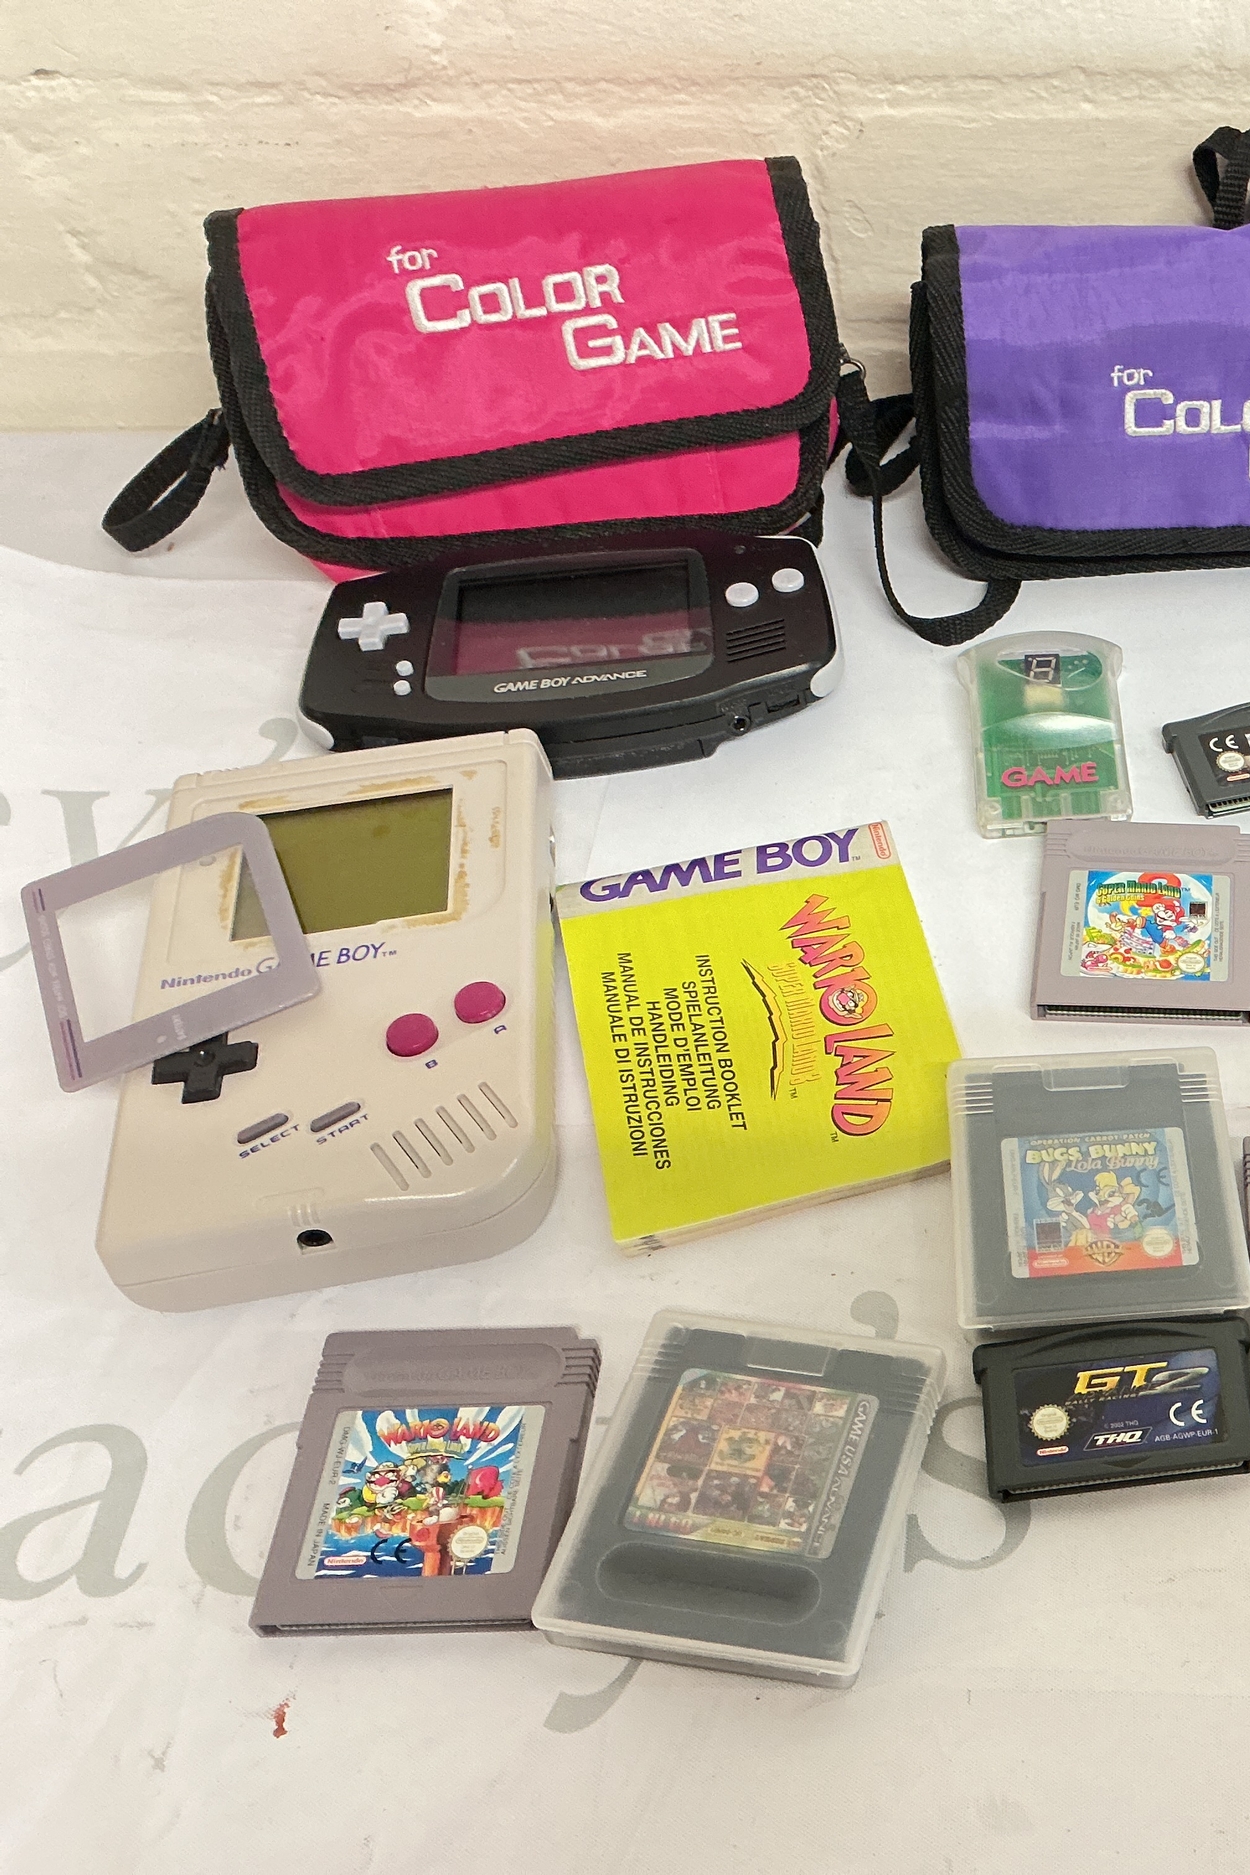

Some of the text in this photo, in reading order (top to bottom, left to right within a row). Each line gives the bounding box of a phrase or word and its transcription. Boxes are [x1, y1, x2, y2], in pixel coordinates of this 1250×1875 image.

[386, 245, 439, 274] for
[404, 263, 625, 334] COLOR
[561, 312, 743, 371] GAME
[1110, 365, 1154, 387] for
[493, 668, 648, 695] GAME BOY ADVANCE
[1001, 761, 1099, 790] GAME
[869, 822, 888, 859] Nintendo
[579, 849, 743, 903] GAME
[755, 827, 860, 873] BOY
[160, 966, 253, 990] Nintendo
[336, 942, 384, 964] BOY
[617, 952, 672, 1170] MANUAL DE INSTRUCCIONES
[646, 1000, 680, 1107] HANDLEIDING
[663, 987, 702, 1112] MODE D'EMPLOI
[681, 980, 722, 1111] SPIELANLEITUNG
[695, 954, 748, 1131] INSTRUCTION BOOKLET
[601, 971, 648, 1158] MANUALE DI ISTRUZIONI
[824, 1021, 895, 1138] LAND
[238, 1124, 300, 1160] SELECT
[315, 1113, 370, 1146] START
[1025, 1141, 1158, 1164] BUGS BUNNY
[1074, 1362, 1169, 1395] GT
[452, 1416, 501, 1442] LAND
[1093, 1430, 1144, 1446] THQ
